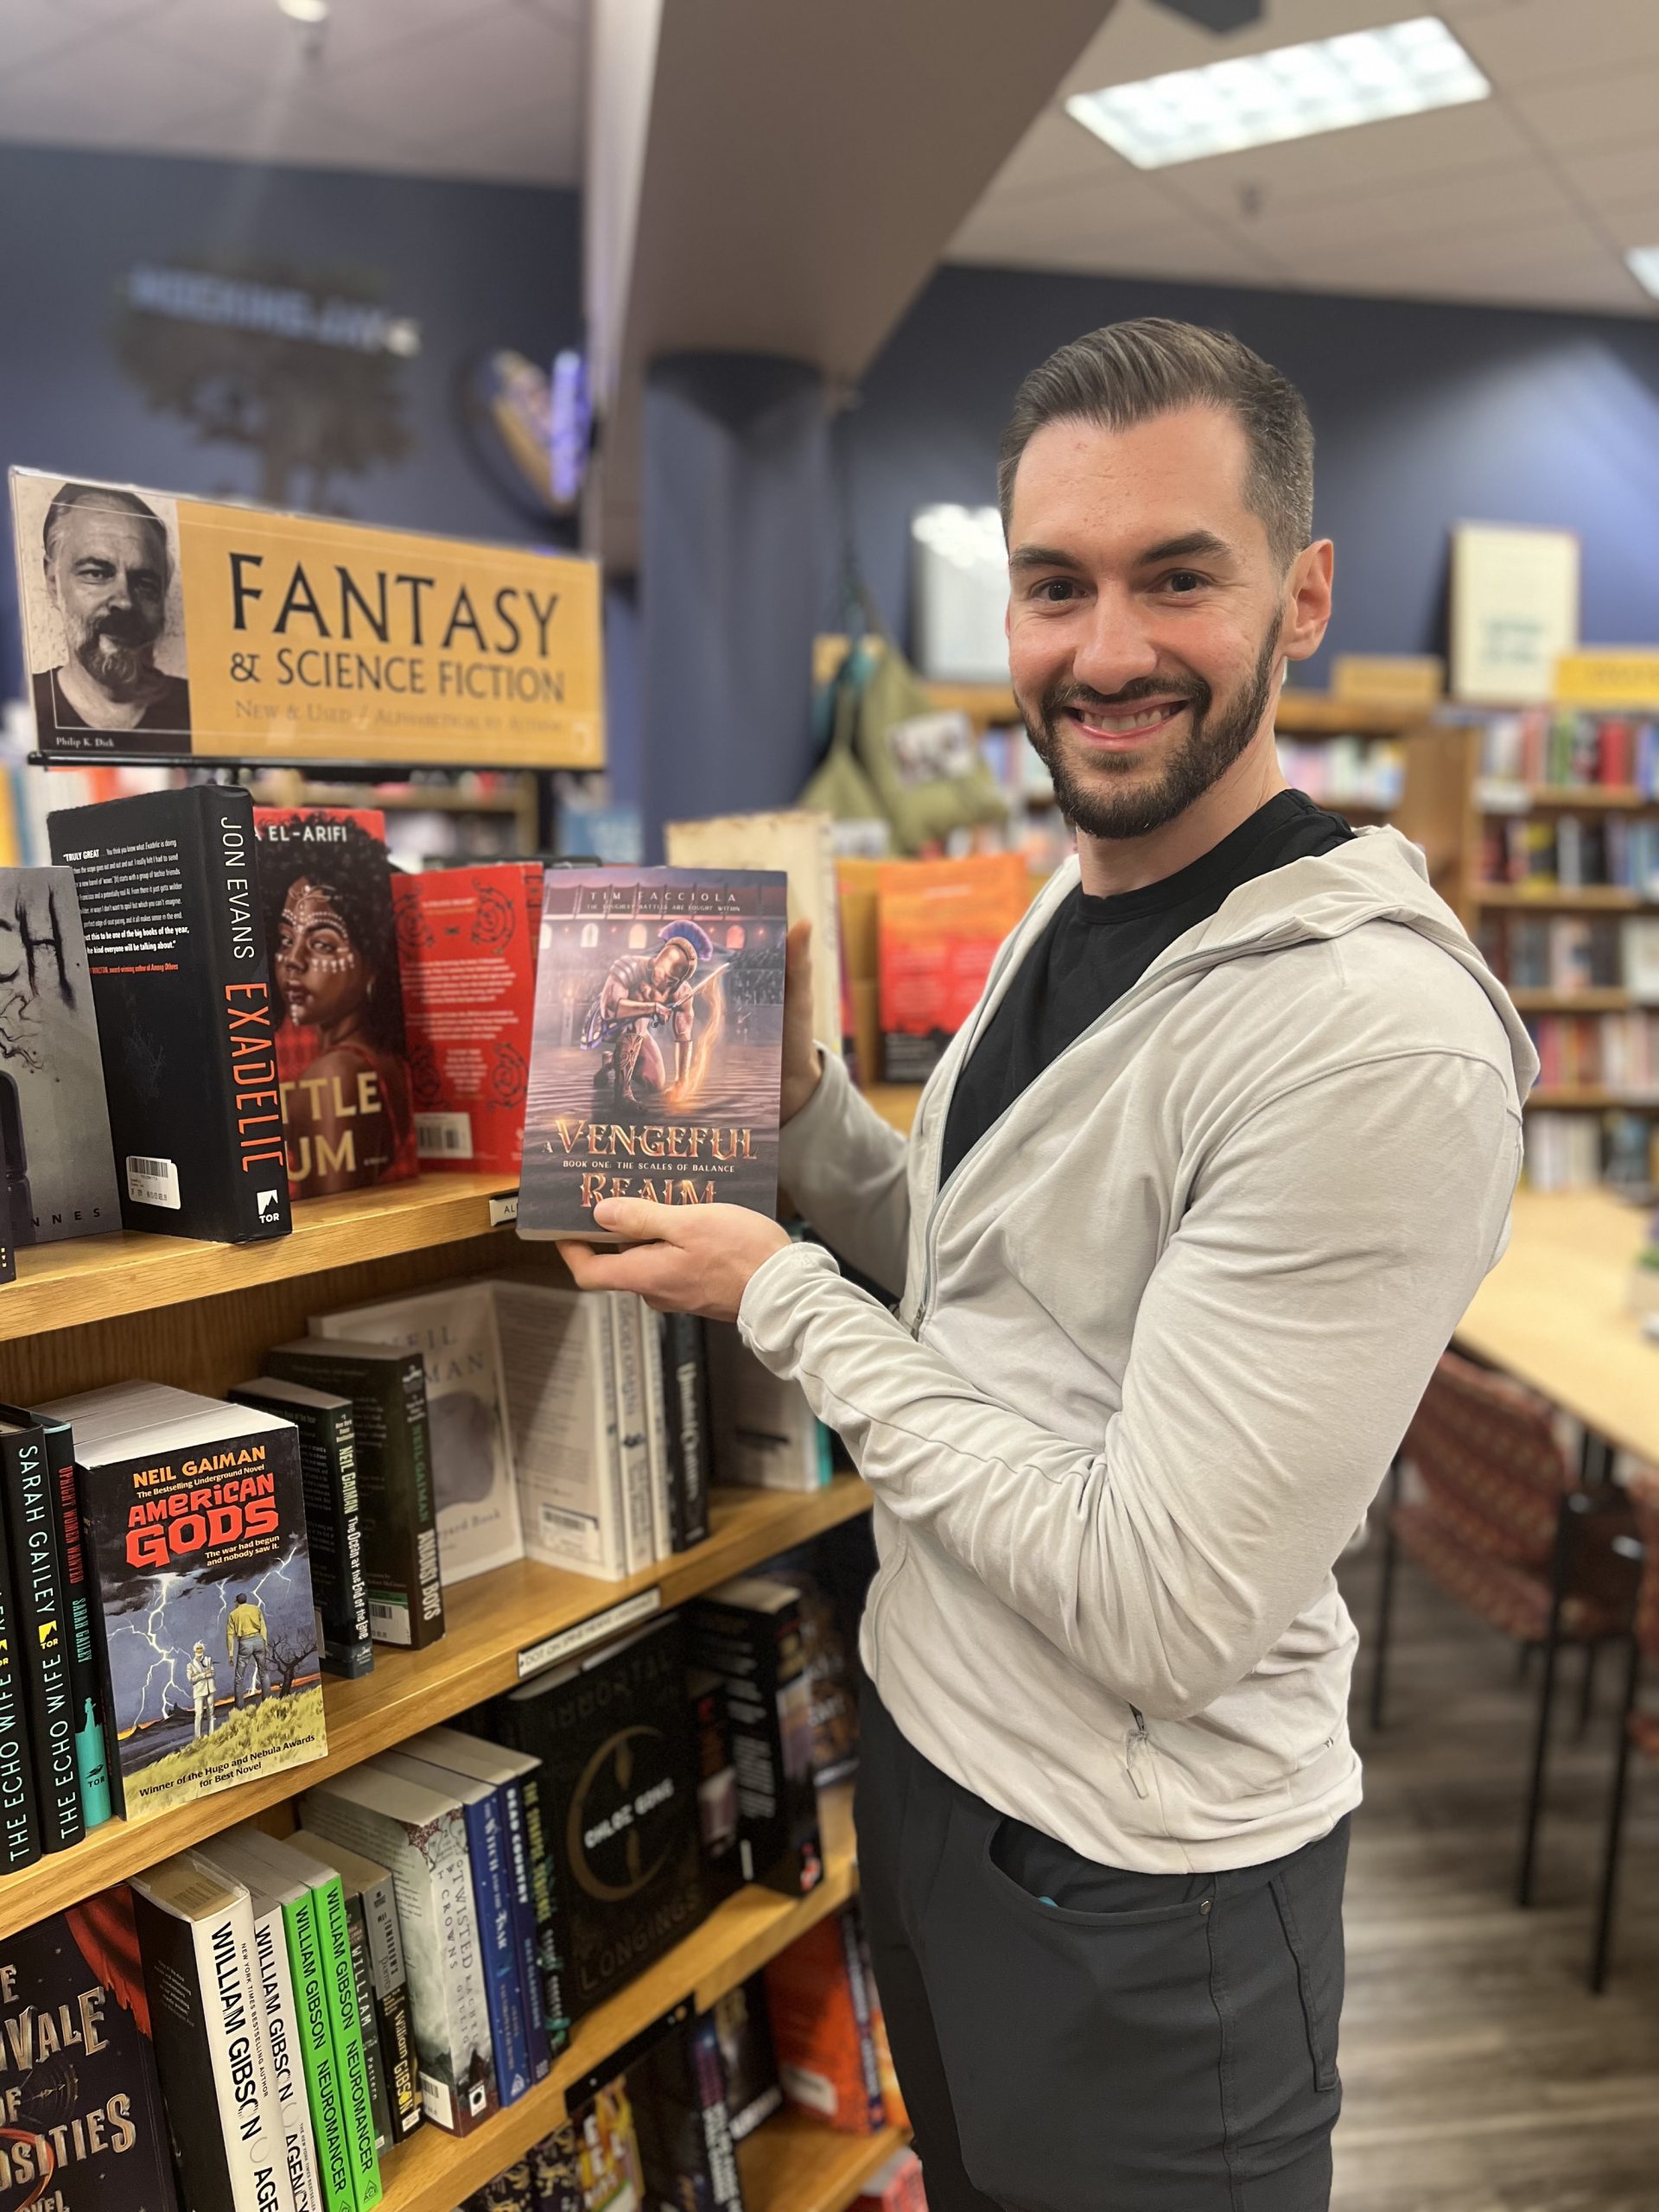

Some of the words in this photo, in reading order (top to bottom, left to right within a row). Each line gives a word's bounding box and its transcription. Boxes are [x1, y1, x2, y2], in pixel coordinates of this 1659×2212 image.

[229, 551, 560, 659] FANTASY
[230, 652, 261, 683] &
[276, 647, 425, 694] SCIENCE
[439, 660, 565, 705] FICTION
[56, 737, 81, 748] Philip
[95, 738, 115, 747] Dick
[83, 849, 99, 859] GREAT
[220, 817, 245, 867] JON
[269, 825, 347, 841] EL-ARIFI
[590, 892, 621, 900] TIM
[638, 892, 737, 903] FACCIOLA
[717, 906, 741, 915] WITHIN
[126, 929, 135, 938] the
[134, 929, 143, 938] big
[143, 927, 158, 936] books
[158, 926, 165, 935] of
[175, 925, 189, 935] year,
[227, 879, 255, 959] EVANS
[93, 945, 105, 954] kind
[105, 946, 124, 956] everyone
[132, 943, 140, 951] be
[140, 942, 157, 952] talking
[225, 982, 284, 1173] EXADELIC
[543, 1141, 554, 1154] A
[555, 1119, 758, 1160] VENGEFUL
[563, 1160, 588, 1169] BOOK
[592, 1161, 613, 1170] ONE:
[617, 1161, 633, 1171] THE
[639, 1162, 673, 1173] SCALES
[677, 1164, 690, 1173] OF
[693, 1164, 736, 1174] BALANCE
[259, 1212, 280, 1224] TOR
[133, 1466, 176, 1488] NEIL
[181, 1446, 266, 1477] GAIMAN
[153, 1483, 194, 1496] Bestselling
[194, 1470, 243, 1486] Underground
[244, 1464, 265, 1474] Novel
[339, 1446, 354, 1472] NEIL
[18, 1446, 46, 1523] SARAH
[59, 1465, 77, 1508] UPRIGHT
[341, 1471, 359, 1516] GAIMAN
[63, 1509, 80, 1545] WOMEN
[125, 1495, 279, 1568] GODS
[347, 1516, 359, 1534] The
[348, 1532, 361, 1560] Ocean
[67, 1544, 85, 1585] WANTED
[205, 1550, 220, 1559] The
[238, 1541, 253, 1550] had
[255, 1535, 280, 1548] begun
[207, 1557, 222, 1566] and
[224, 1549, 253, 1562] nobody
[255, 1547, 269, 1555] saw
[269, 1542, 280, 1551] it.
[351, 1558, 359, 1569] at
[28, 1532, 55, 1614] GAILEY
[353, 1567, 362, 1583] the
[353, 1581, 365, 1600] End
[73, 1597, 89, 1630] SARAH
[355, 1598, 364, 1609] of
[356, 1608, 365, 1623] the
[421, 1580, 442, 1621] BOYS
[41, 1637, 59, 1649] TOR
[75, 1630, 92, 1663] GAILEY
[358, 1620, 370, 1641] Lane
[43, 1654, 66, 1714] WIFE
[0, 1741, 25, 1808] ECHO
[49, 1720, 73, 1787] ECHO
[139, 1780, 174, 1797] Winner
[176, 1775, 187, 1785] of
[187, 1771, 203, 1782] the
[205, 1763, 230, 1776] Hugo
[232, 1755, 249, 1767] and
[250, 1746, 281, 1761] Nebula
[283, 1734, 315, 1751] Awards
[87, 1777, 105, 1788] TOR
[199, 1777, 213, 1789] for
[215, 1771, 234, 1783] Best
[236, 1761, 262, 1779] Novel
[524, 1781, 538, 1806] THE
[57, 1791, 79, 1840] THE
[506, 1788, 520, 1831] DEAD
[7, 1814, 30, 1862] THE
[484, 1818, 500, 1872] WITCH
[511, 1834, 528, 1904] COUNTRY
[326, 1885, 346, 1960] WILLIAM
[442, 1889, 458, 1970] CROWNS
[452, 1871, 473, 1969] TWISTED
[295, 1904, 317, 1979] WILLIAM
[243, 1961, 252, 1984] YORK
[352, 1945, 372, 2028] WILLIAM
[247, 1986, 257, 2010] TIMES
[255, 1923, 282, 2016] WILLIAM
[269, 2018, 295, 2102] GIBSON
[305, 1978, 326, 2050] GIBSON
[335, 1961, 354, 2031] GIBSON
[211, 1921, 245, 2036] WILLIAM
[228, 2037, 263, 2142] GIBSON
[251, 2011, 264, 2064] BESTSELLING
[394, 2009, 408, 2060] William
[258, 2066, 269, 2098] AUTHOR
[366, 2056, 378, 2101] Pattern
[393, 2062, 415, 2116] GIBSON
[316, 2059, 347, 2195] NEUROMANCER
[346, 2039, 374, 2174] NEUROMANCER
